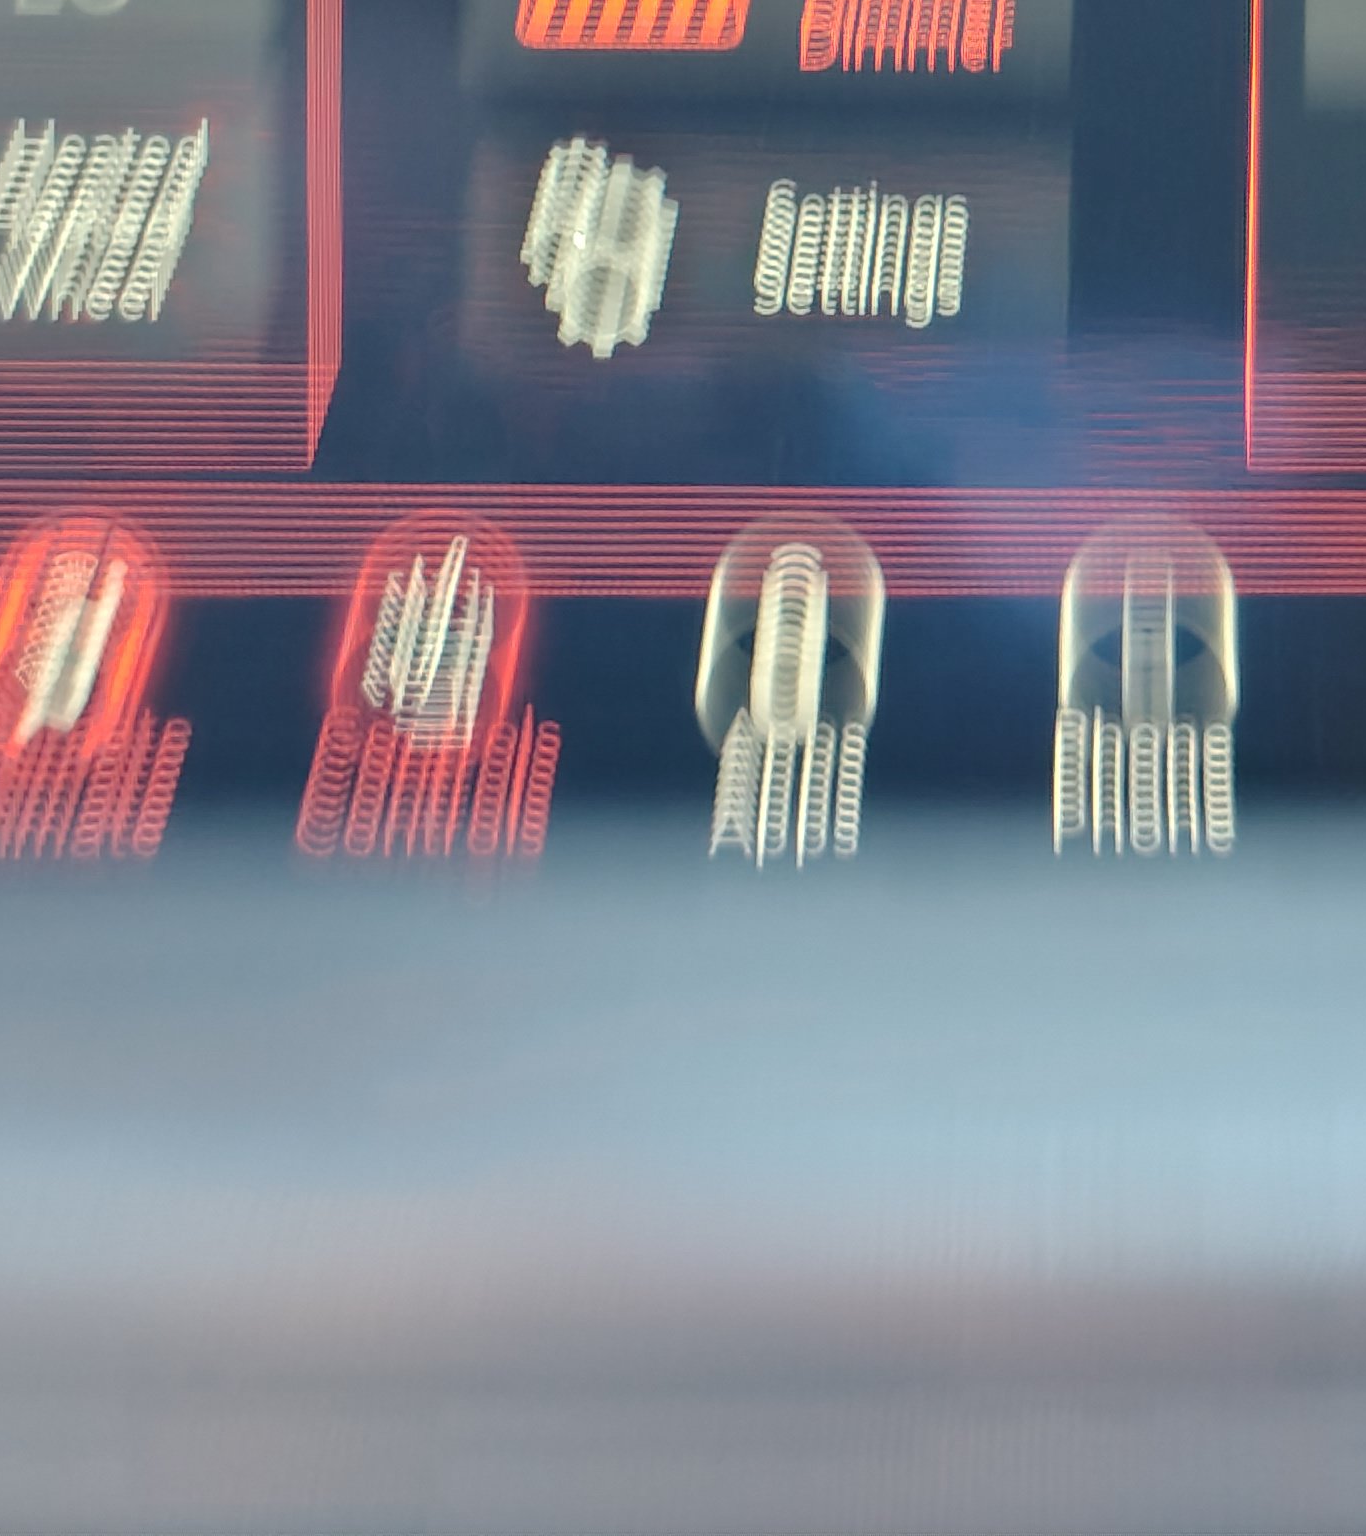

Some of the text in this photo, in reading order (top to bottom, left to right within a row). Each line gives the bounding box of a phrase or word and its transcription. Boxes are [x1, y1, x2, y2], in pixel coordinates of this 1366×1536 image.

[753, 177, 969, 330] Settings
[294, 703, 562, 858] Controls
[707, 705, 867, 870] Apps
[1052, 705, 1236, 858] Phone
